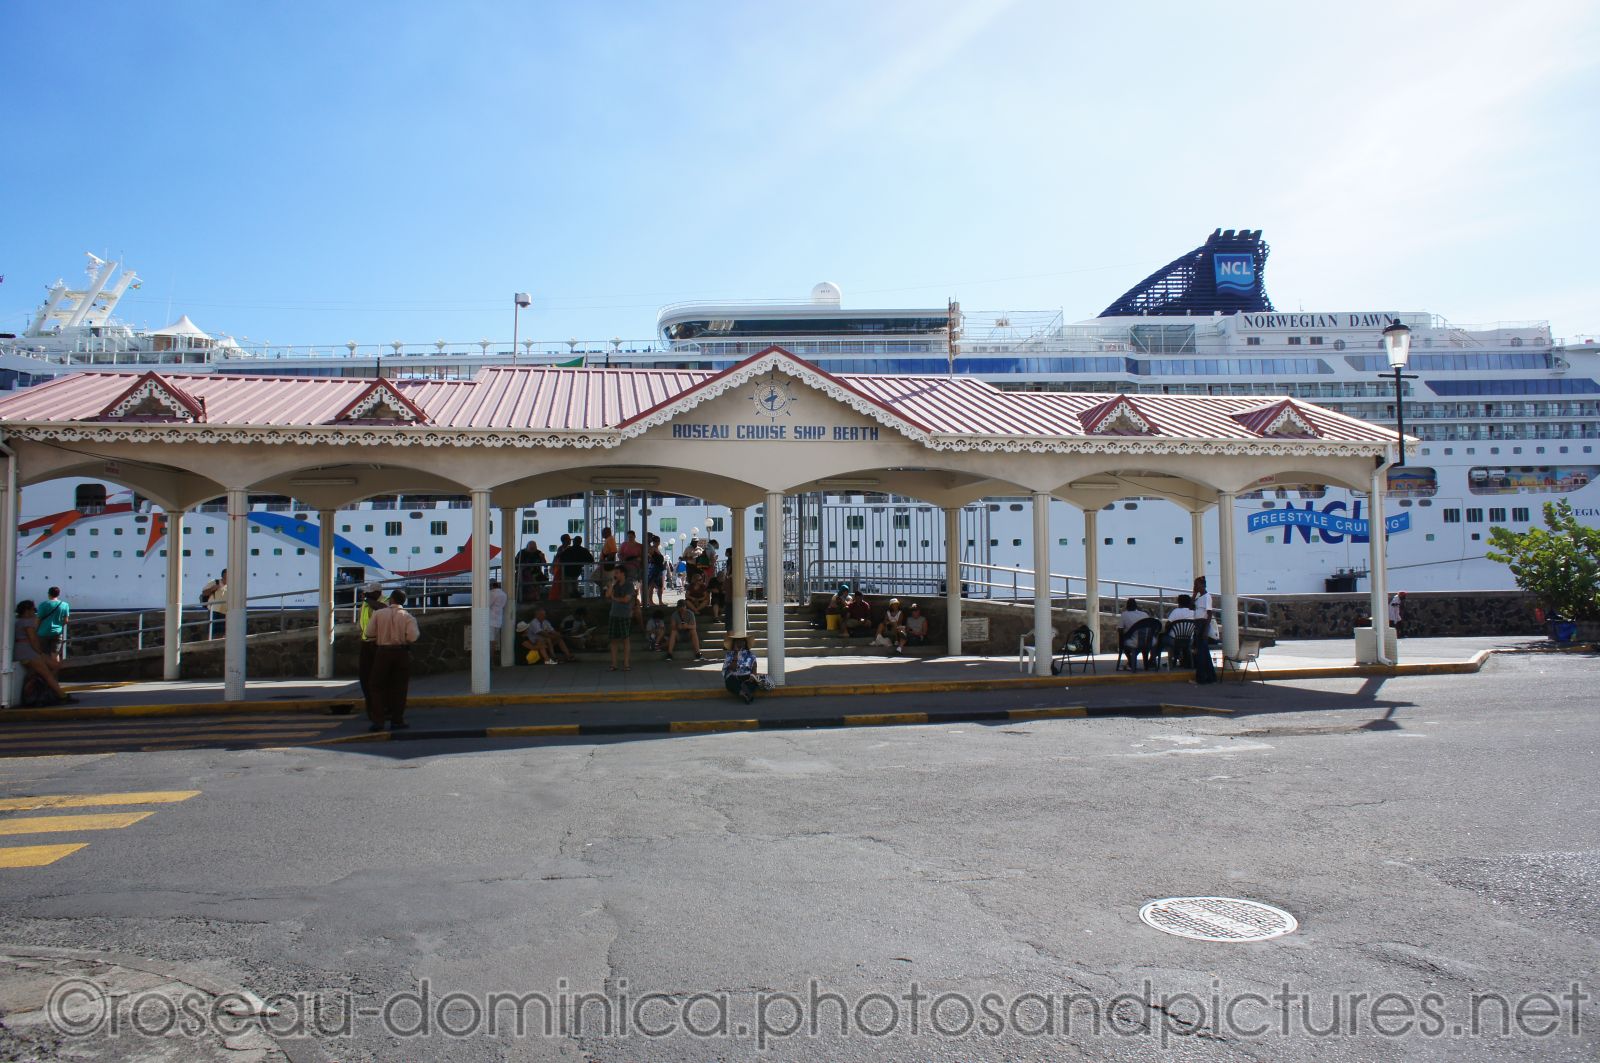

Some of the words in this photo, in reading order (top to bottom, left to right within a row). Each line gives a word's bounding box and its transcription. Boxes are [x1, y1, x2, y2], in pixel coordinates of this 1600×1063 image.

[1220, 261, 1251, 275] NCL
[1244, 313, 1338, 328] NORWEGIAN
[1349, 313, 1394, 327] DAWN
[672, 423, 729, 439] ROSEAU
[736, 424, 787, 440] CRUISE
[793, 425, 826, 440] SHIP
[832, 426, 879, 441] BERTH
[1252, 512, 1329, 528] FREESTYLE
